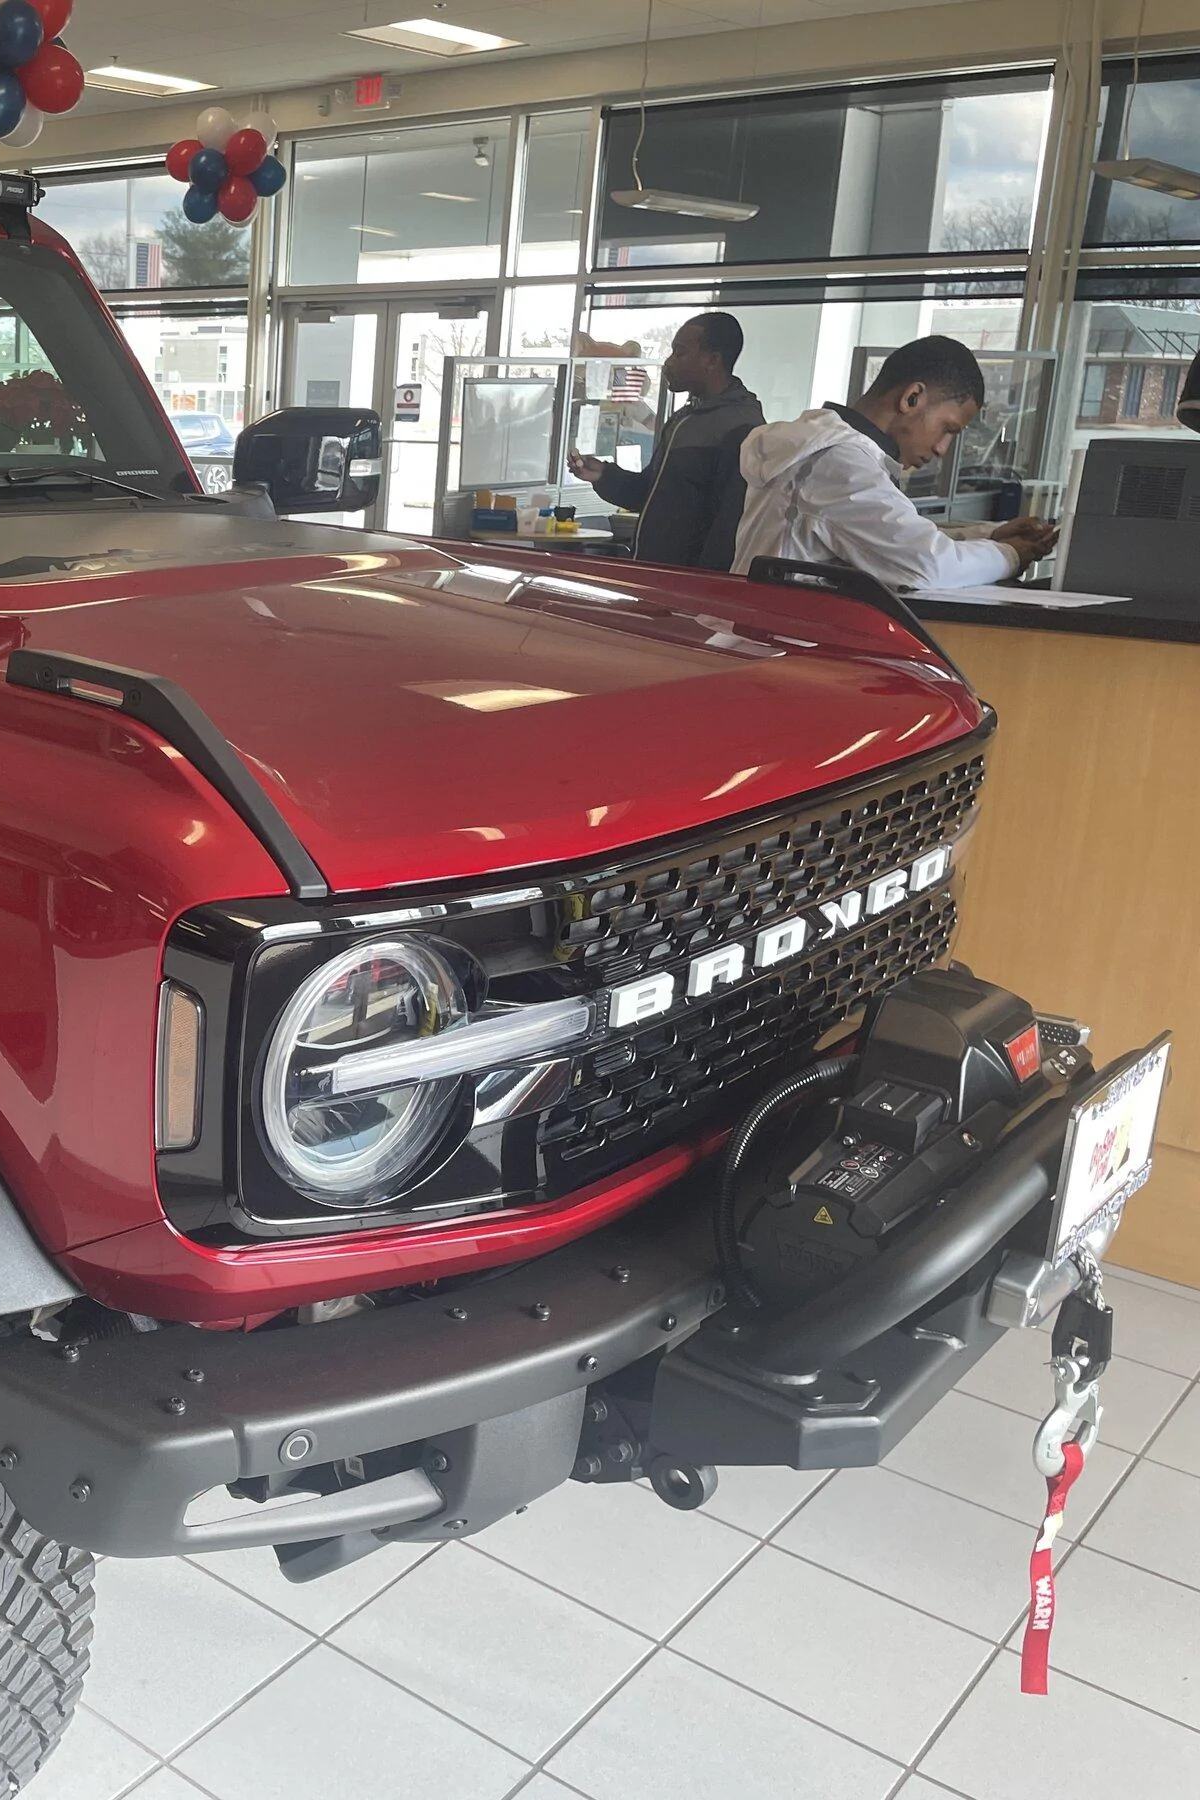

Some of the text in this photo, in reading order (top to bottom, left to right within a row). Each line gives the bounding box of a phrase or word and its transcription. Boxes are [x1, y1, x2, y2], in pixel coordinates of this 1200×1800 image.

[115, 469, 159, 477] BRONCO
[609, 846, 948, 1029] BRONCO
[1032, 1575, 1053, 1630] WARN
